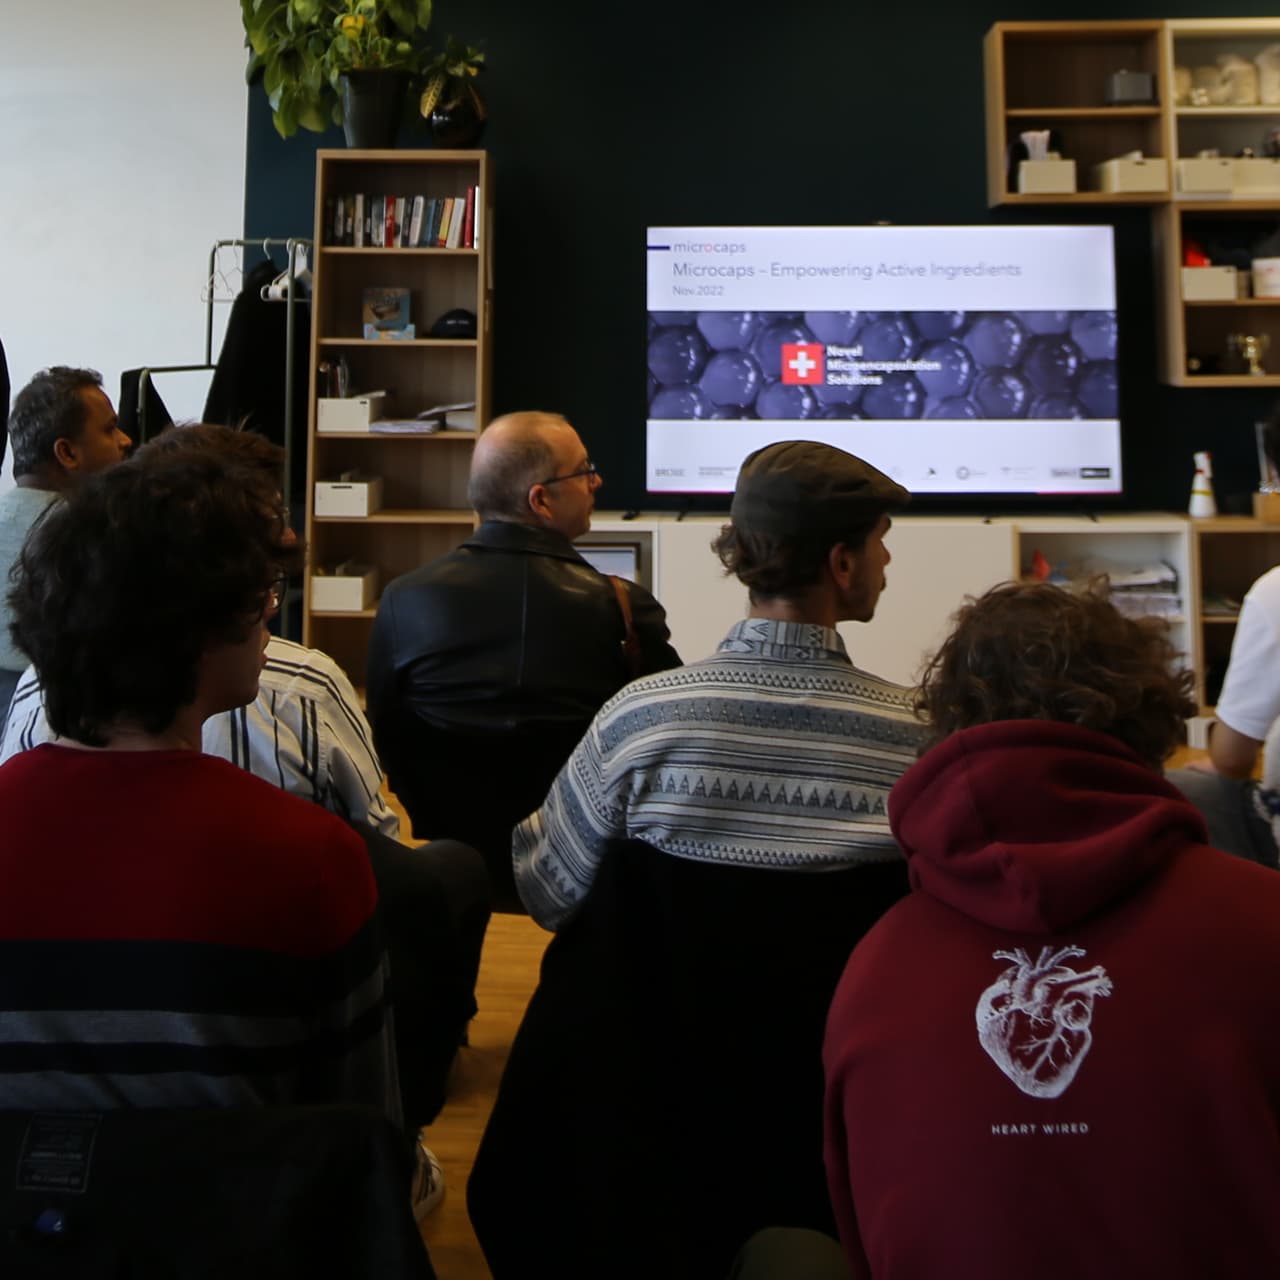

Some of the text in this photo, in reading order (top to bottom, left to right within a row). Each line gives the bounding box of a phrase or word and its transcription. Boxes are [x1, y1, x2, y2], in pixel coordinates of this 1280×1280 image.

[673, 241, 746, 255] microcaps
[672, 262, 755, 279] Microcaps
[770, 262, 873, 280] Empowering
[876, 263, 927, 277] Active
[931, 262, 1022, 280] Ingredients
[827, 345, 863, 357] Novel
[827, 373, 883, 385] Solutions
[991, 1123, 1089, 1135] HEART WIRED
